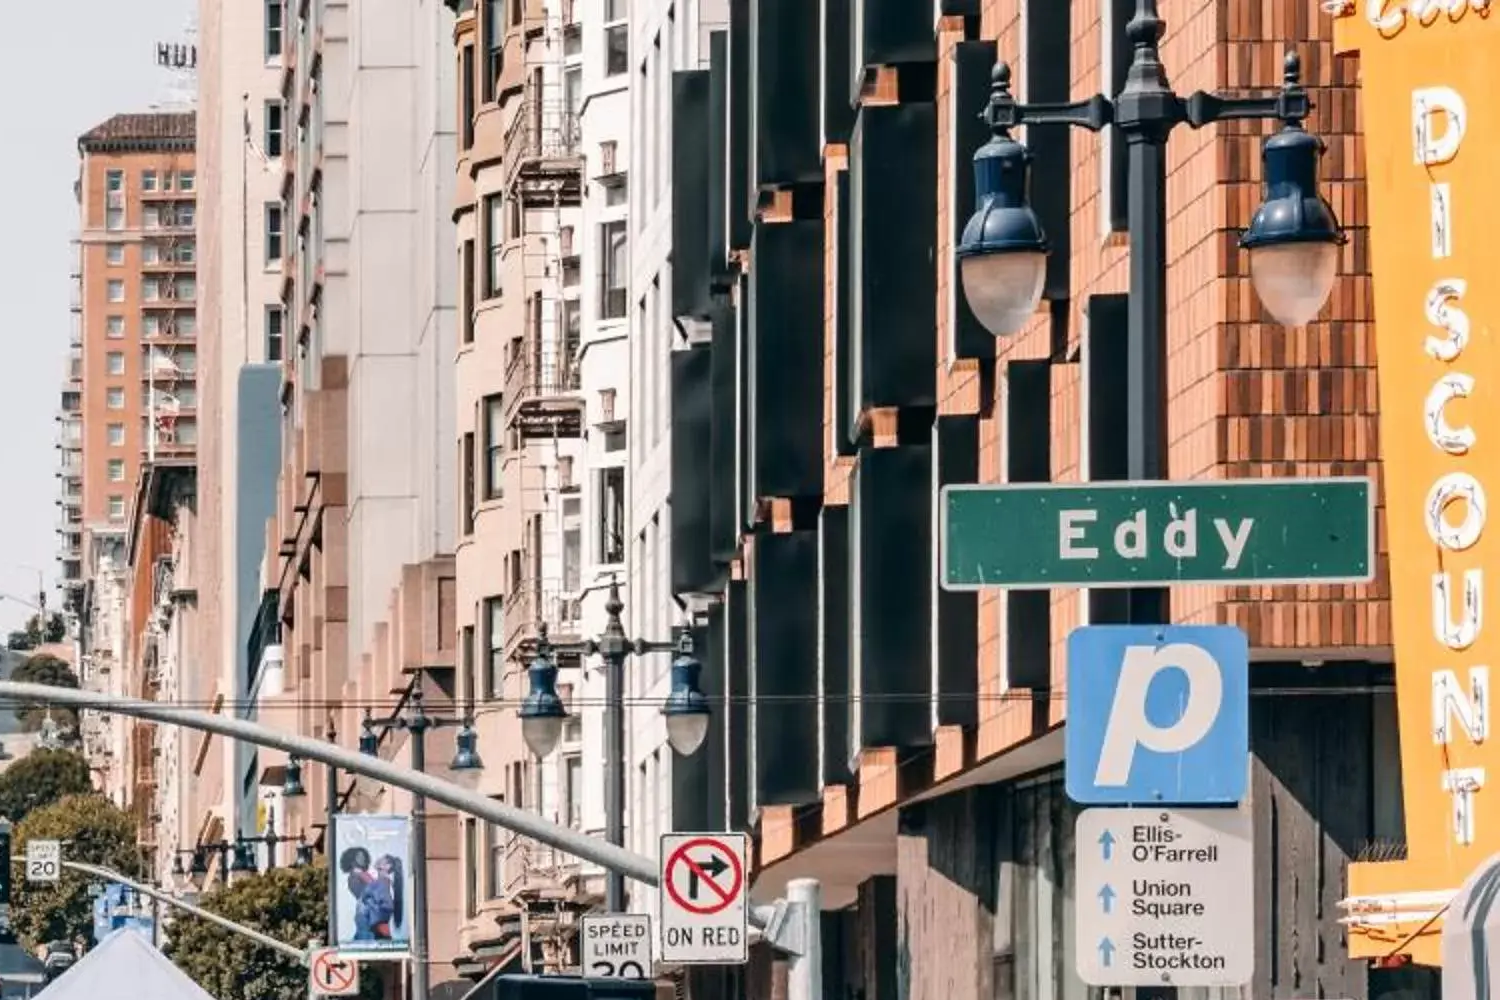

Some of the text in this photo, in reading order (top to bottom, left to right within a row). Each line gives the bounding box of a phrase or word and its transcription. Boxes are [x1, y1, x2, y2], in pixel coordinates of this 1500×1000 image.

[1411, 85, 1489, 845] DISCOUNT
[1059, 508, 1254, 570] Eddy
[1132, 825, 1183, 843] Ellis-
[1131, 845, 1218, 862] O'Farrell
[31, 861, 55, 876] 20
[1132, 879, 1192, 897] Union
[1131, 899, 1205, 919] Square
[588, 924, 646, 938] SPEED
[667, 927, 740, 946] ON RED
[594, 941, 639, 956] LIMIT
[1132, 932, 1203, 950] Sutter-
[1132, 952, 1226, 969] Stockton
